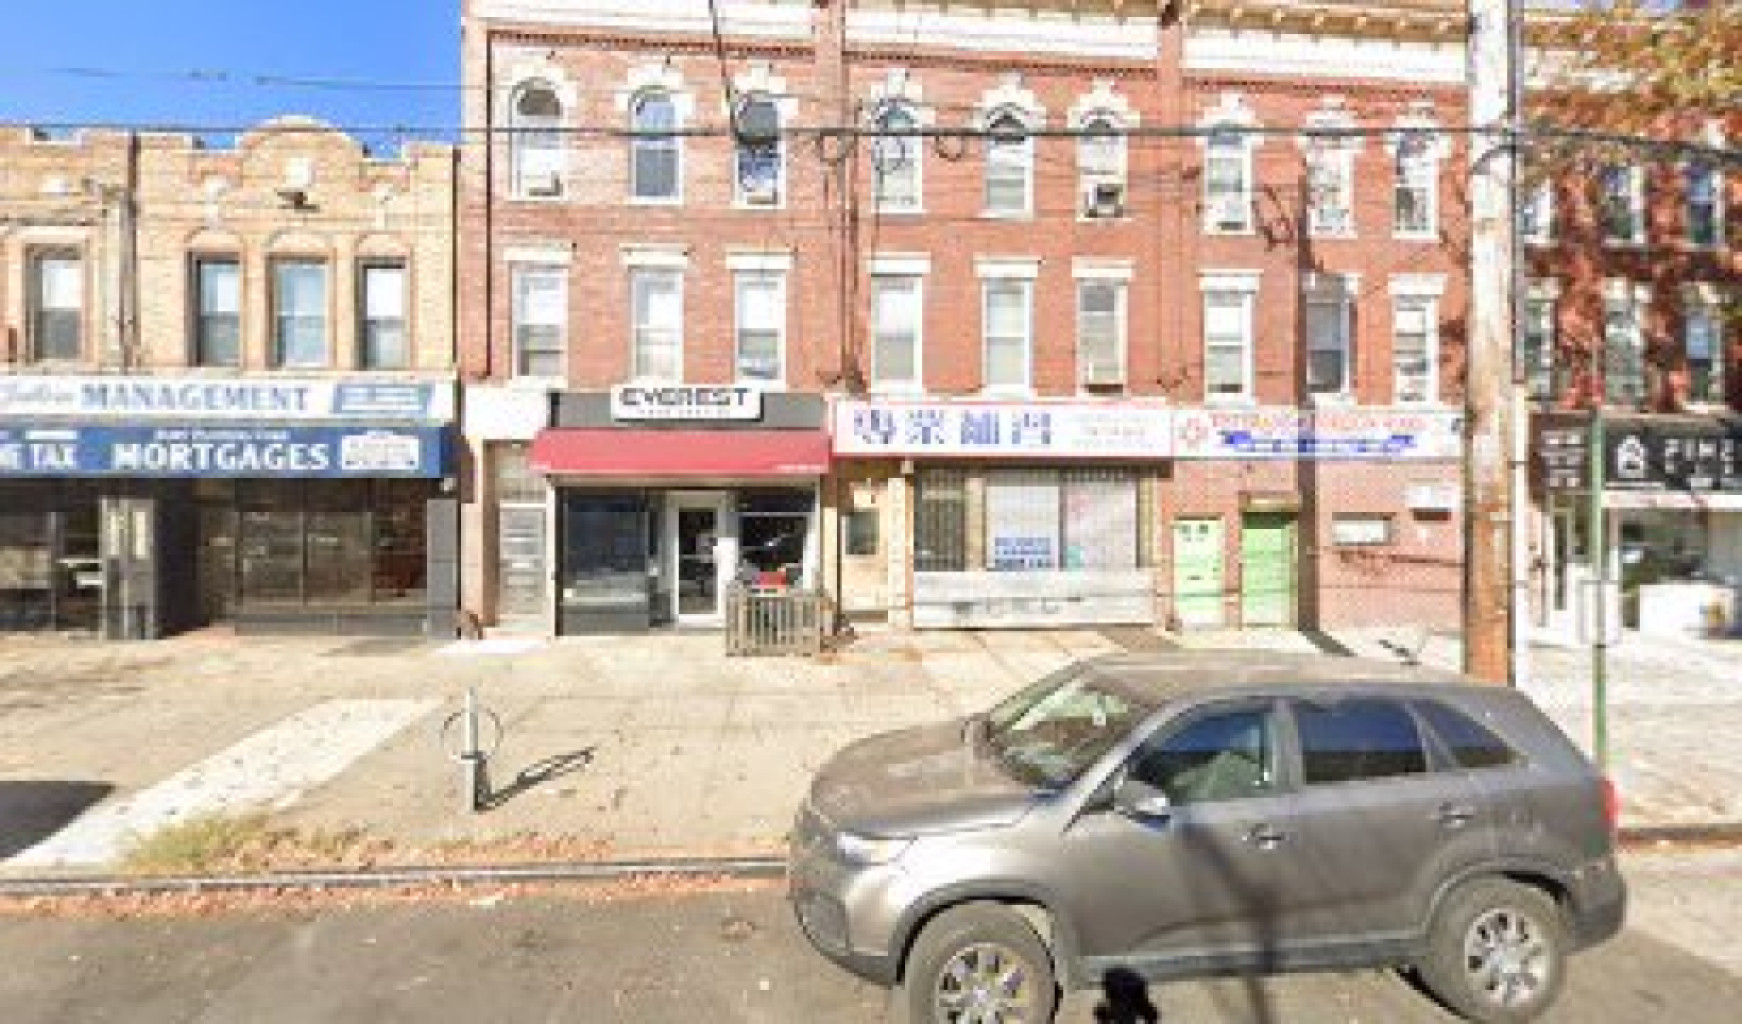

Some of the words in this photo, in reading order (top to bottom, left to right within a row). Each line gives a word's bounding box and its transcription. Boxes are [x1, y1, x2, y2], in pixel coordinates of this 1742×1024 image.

[81, 383, 309, 412] MANAGEMENT
[620, 387, 749, 406] EVEREST
[30, 443, 77, 469] TAX
[111, 442, 330, 471] MORTGAGES
